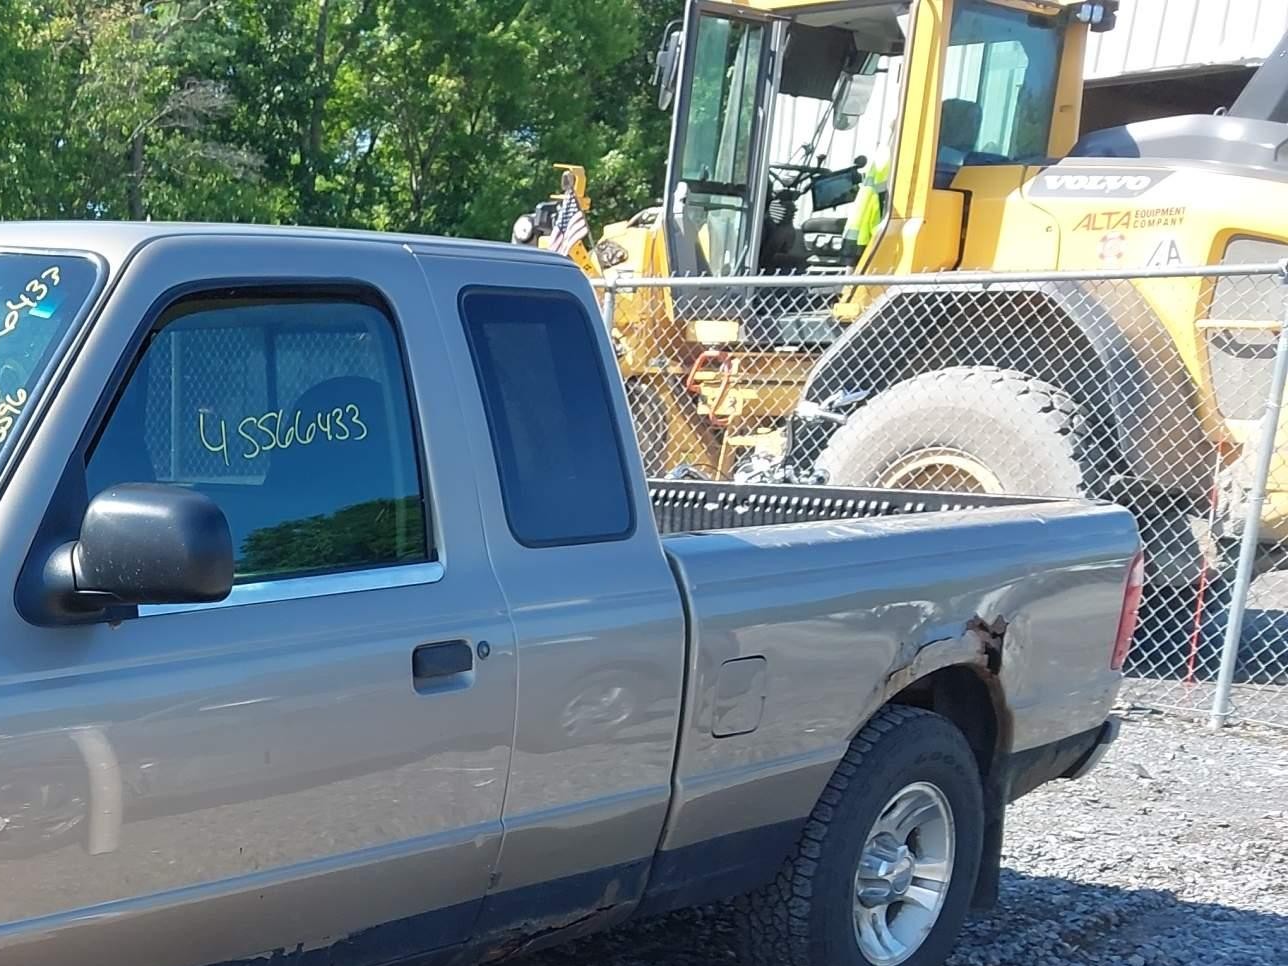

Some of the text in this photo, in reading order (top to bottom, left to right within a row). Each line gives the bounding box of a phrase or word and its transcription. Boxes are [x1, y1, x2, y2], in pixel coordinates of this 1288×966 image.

[1043, 174, 1151, 192] VOLVO
[1134, 206, 1187, 218] EQUIPMENT
[1072, 211, 1132, 232] ALTA
[1132, 217, 1184, 229] COMPANY
